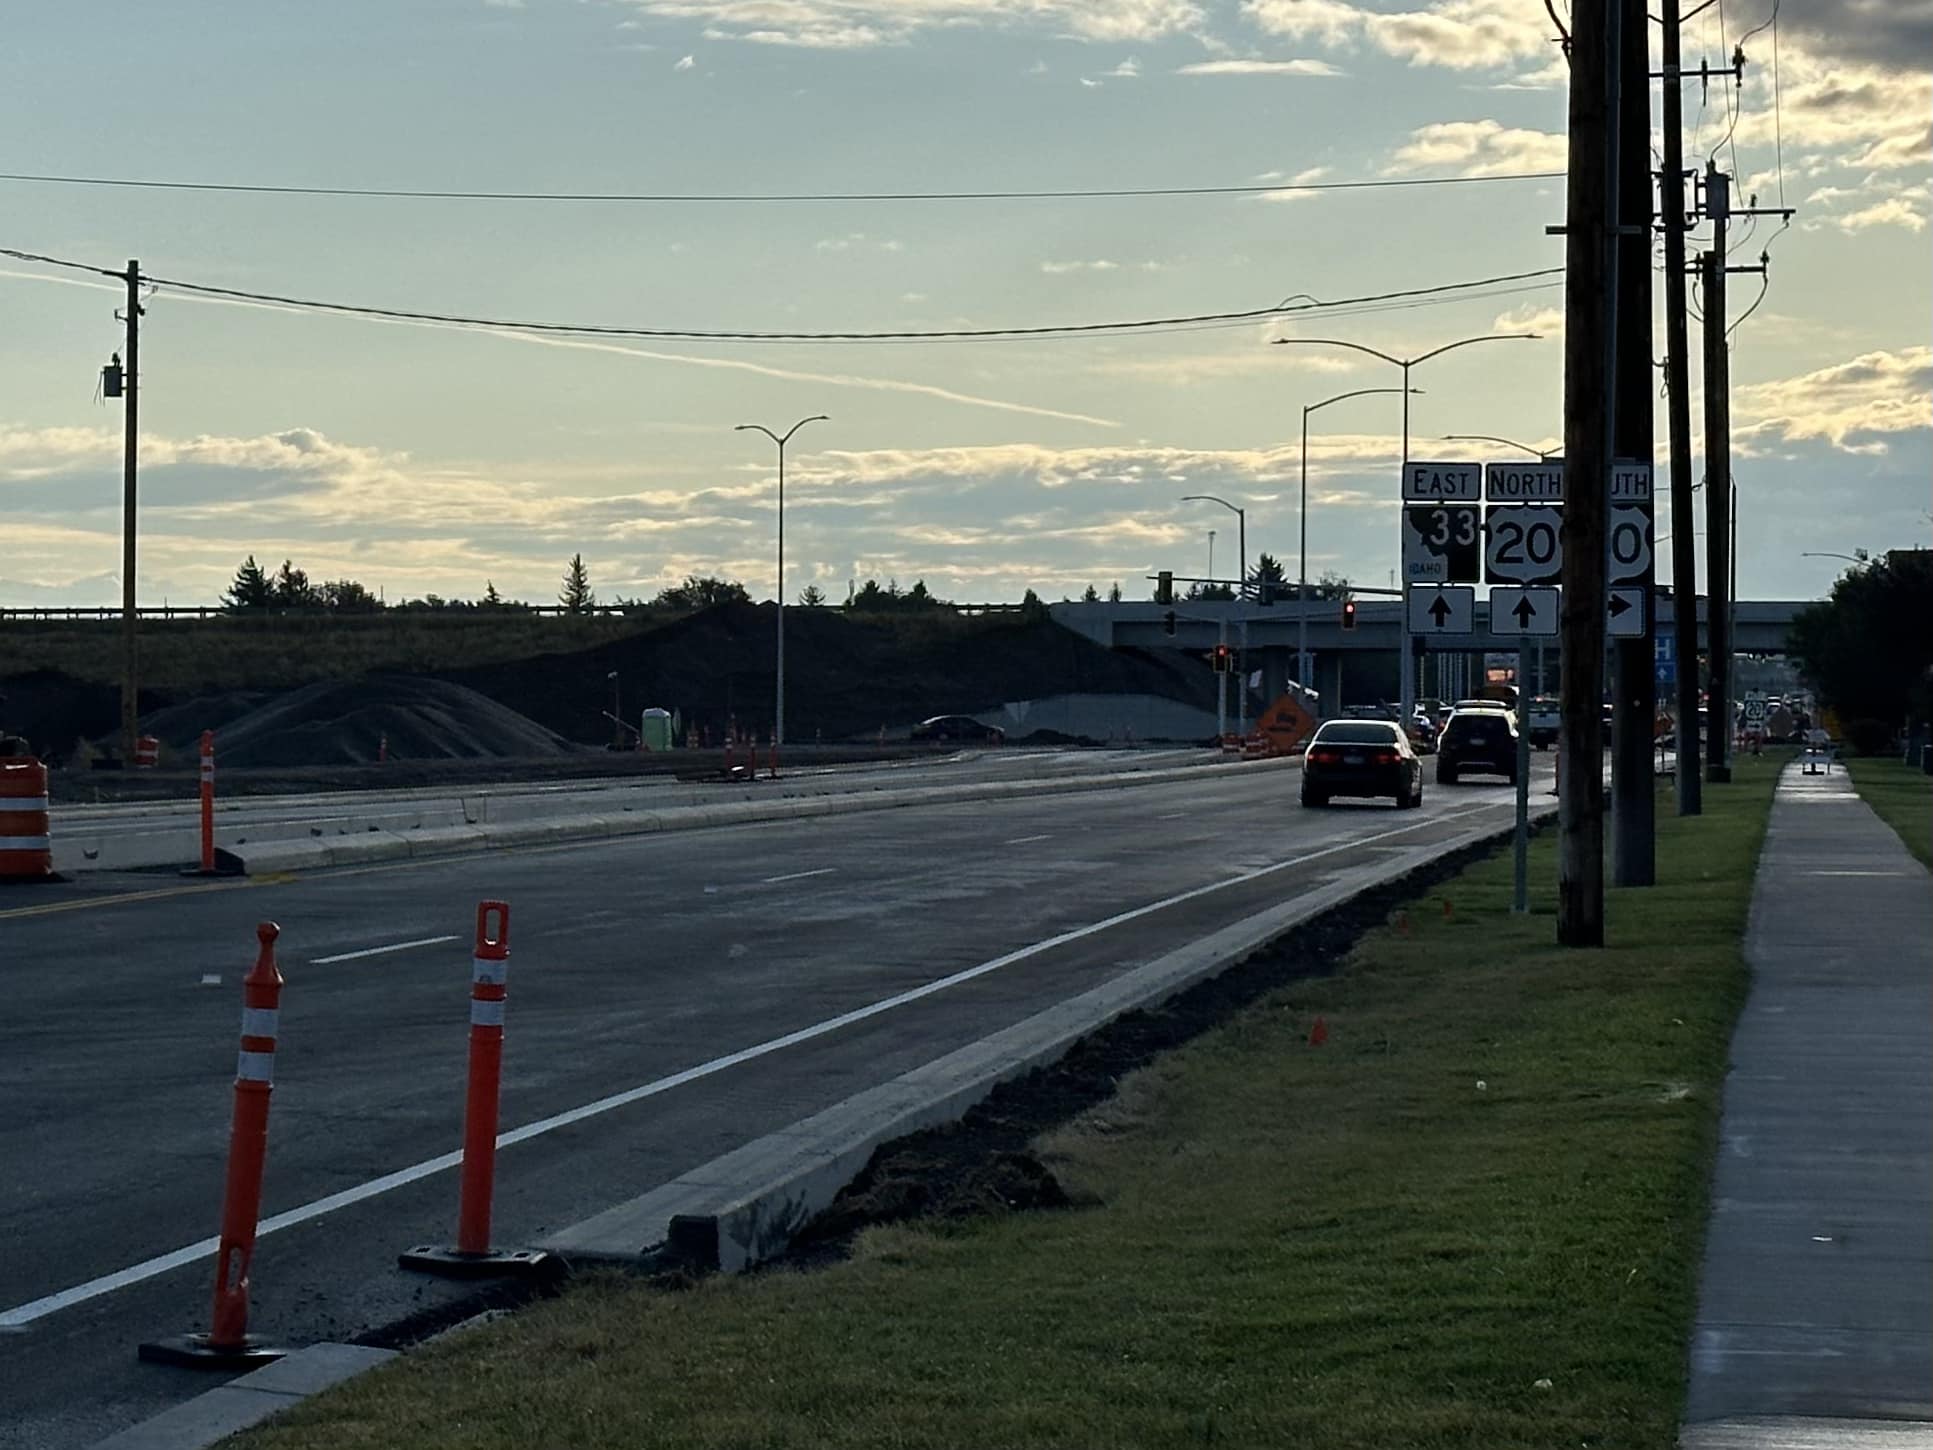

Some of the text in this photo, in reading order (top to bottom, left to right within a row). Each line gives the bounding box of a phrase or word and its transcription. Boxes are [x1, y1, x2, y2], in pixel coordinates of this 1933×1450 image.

[1414, 469, 1469, 495] EAST
[1490, 470, 1562, 495] NORTH
[1611, 472, 1648, 495] UTH
[1429, 509, 1476, 546] 33
[1495, 521, 1556, 564] 20
[1612, 522, 1642, 564] 0
[1408, 563, 1442, 576] IDAHO
[1654, 638, 1670, 660] H
[1748, 702, 1761, 716] 20
